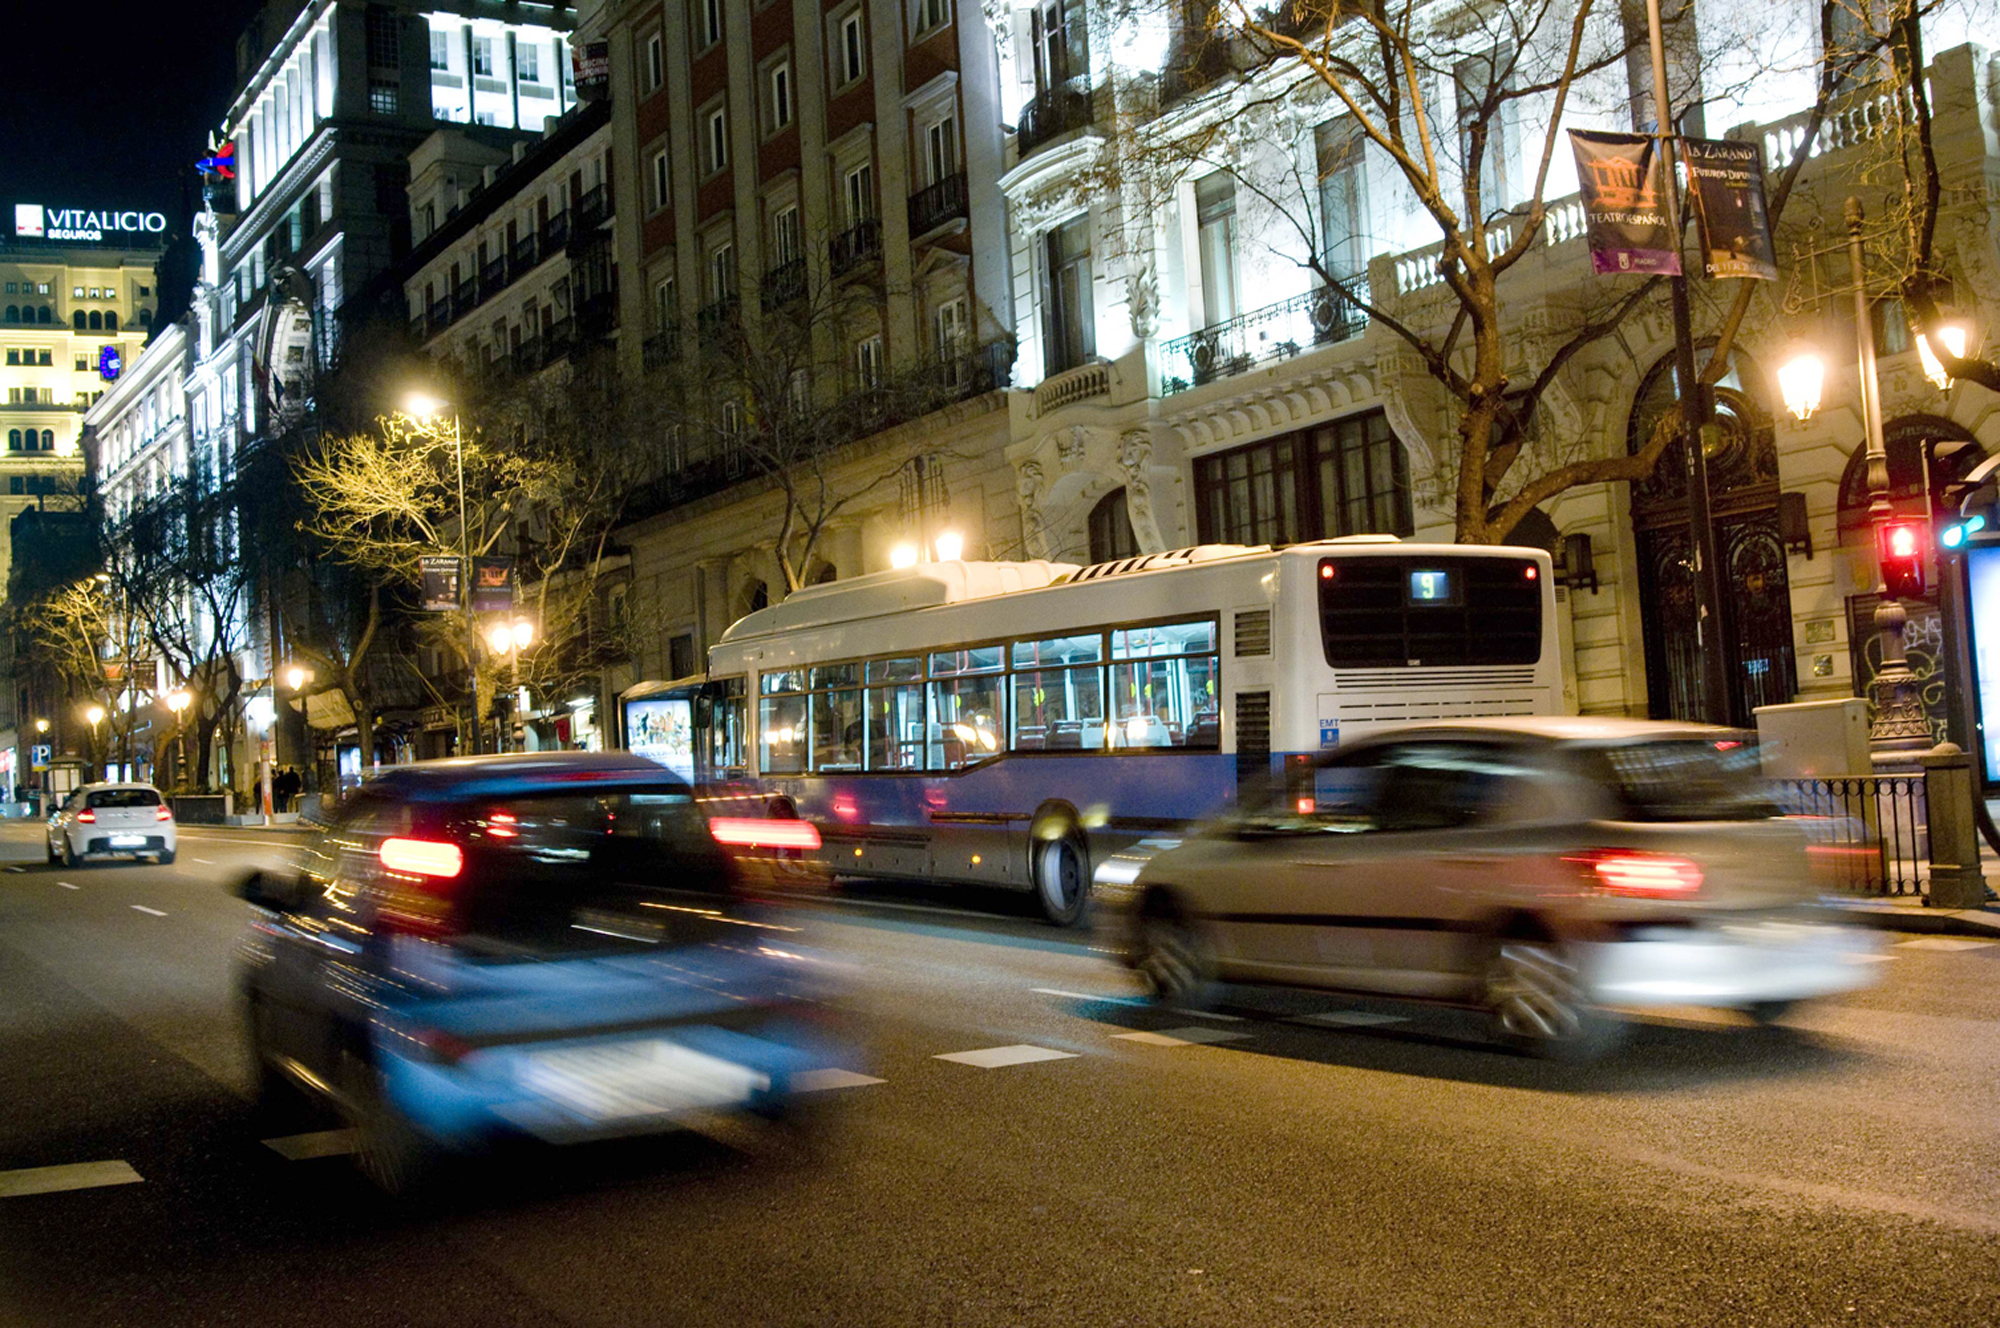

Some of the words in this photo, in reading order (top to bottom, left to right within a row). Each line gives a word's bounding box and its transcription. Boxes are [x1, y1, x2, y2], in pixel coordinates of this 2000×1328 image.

[47, 209, 166, 232] VITALICIO
[48, 229, 102, 240] SEGUROS
[1421, 572, 1435, 599] 9
[1319, 719, 1339, 728] EMT
[37, 747, 49, 763] P
